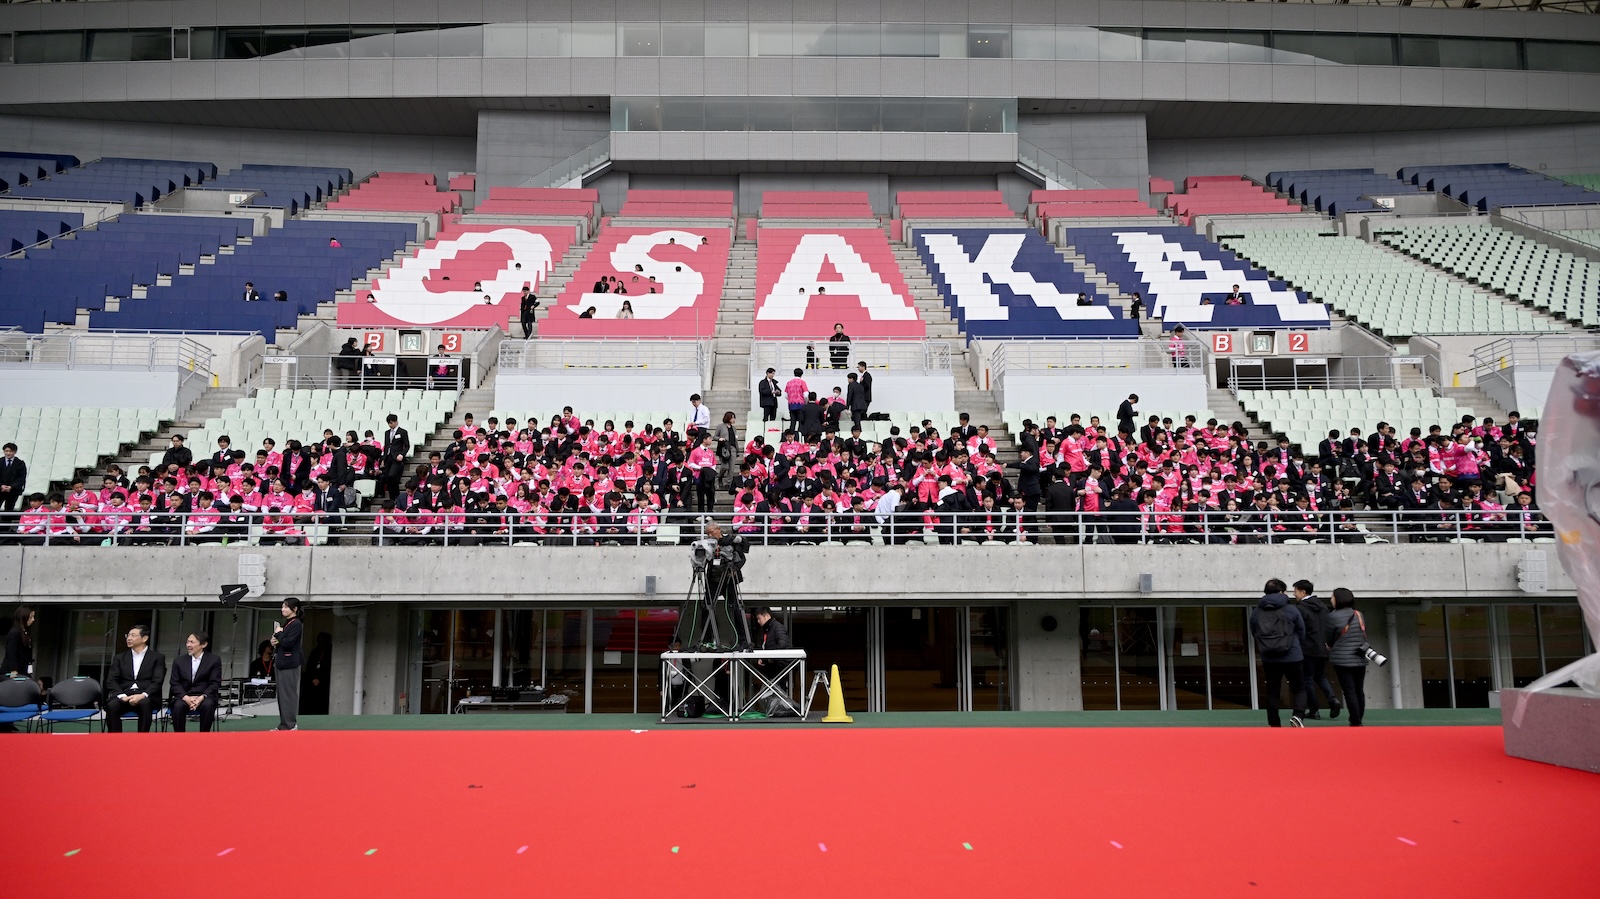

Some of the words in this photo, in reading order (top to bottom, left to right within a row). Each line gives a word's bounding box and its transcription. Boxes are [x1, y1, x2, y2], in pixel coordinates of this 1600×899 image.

[371, 228, 1330, 325] OSAKA
[367, 333, 382, 350] B
[445, 334, 458, 351] 3
[1215, 335, 1230, 352] B
[1292, 334, 1305, 351] 2
